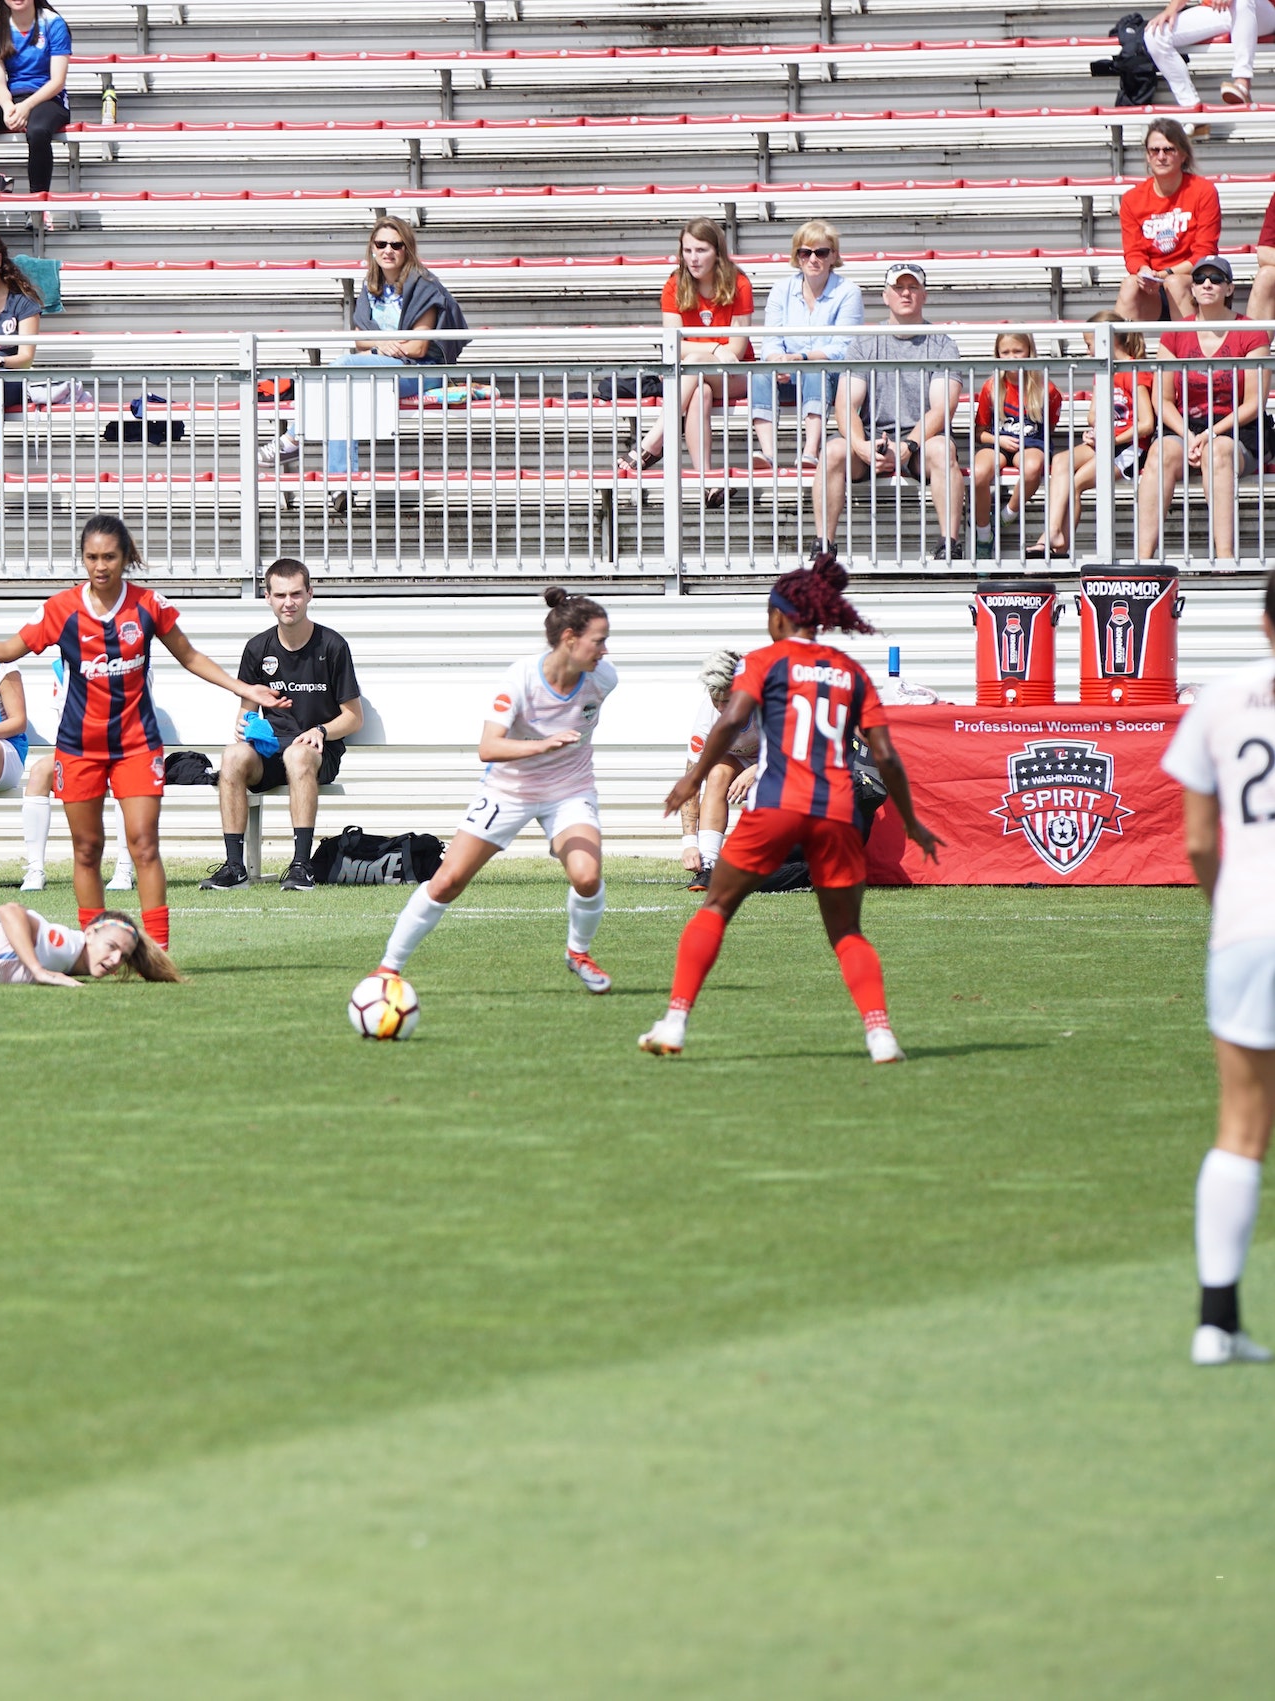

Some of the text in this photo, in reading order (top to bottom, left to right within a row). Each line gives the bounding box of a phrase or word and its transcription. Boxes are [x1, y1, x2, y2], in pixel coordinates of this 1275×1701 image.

[1086, 582, 1161, 596] BODYARMOR
[986, 595, 1043, 607] BODYARMOR
[791, 664, 853, 691] ORDEGA
[792, 694, 848, 768] 14
[954, 719, 1166, 733] Professional Women's Soccer
[1031, 773, 1092, 786] WASHINGTON
[1021, 788, 1102, 811] SPIRIT
[466, 796, 501, 830] 21
[337, 852, 404, 885] NIKE
